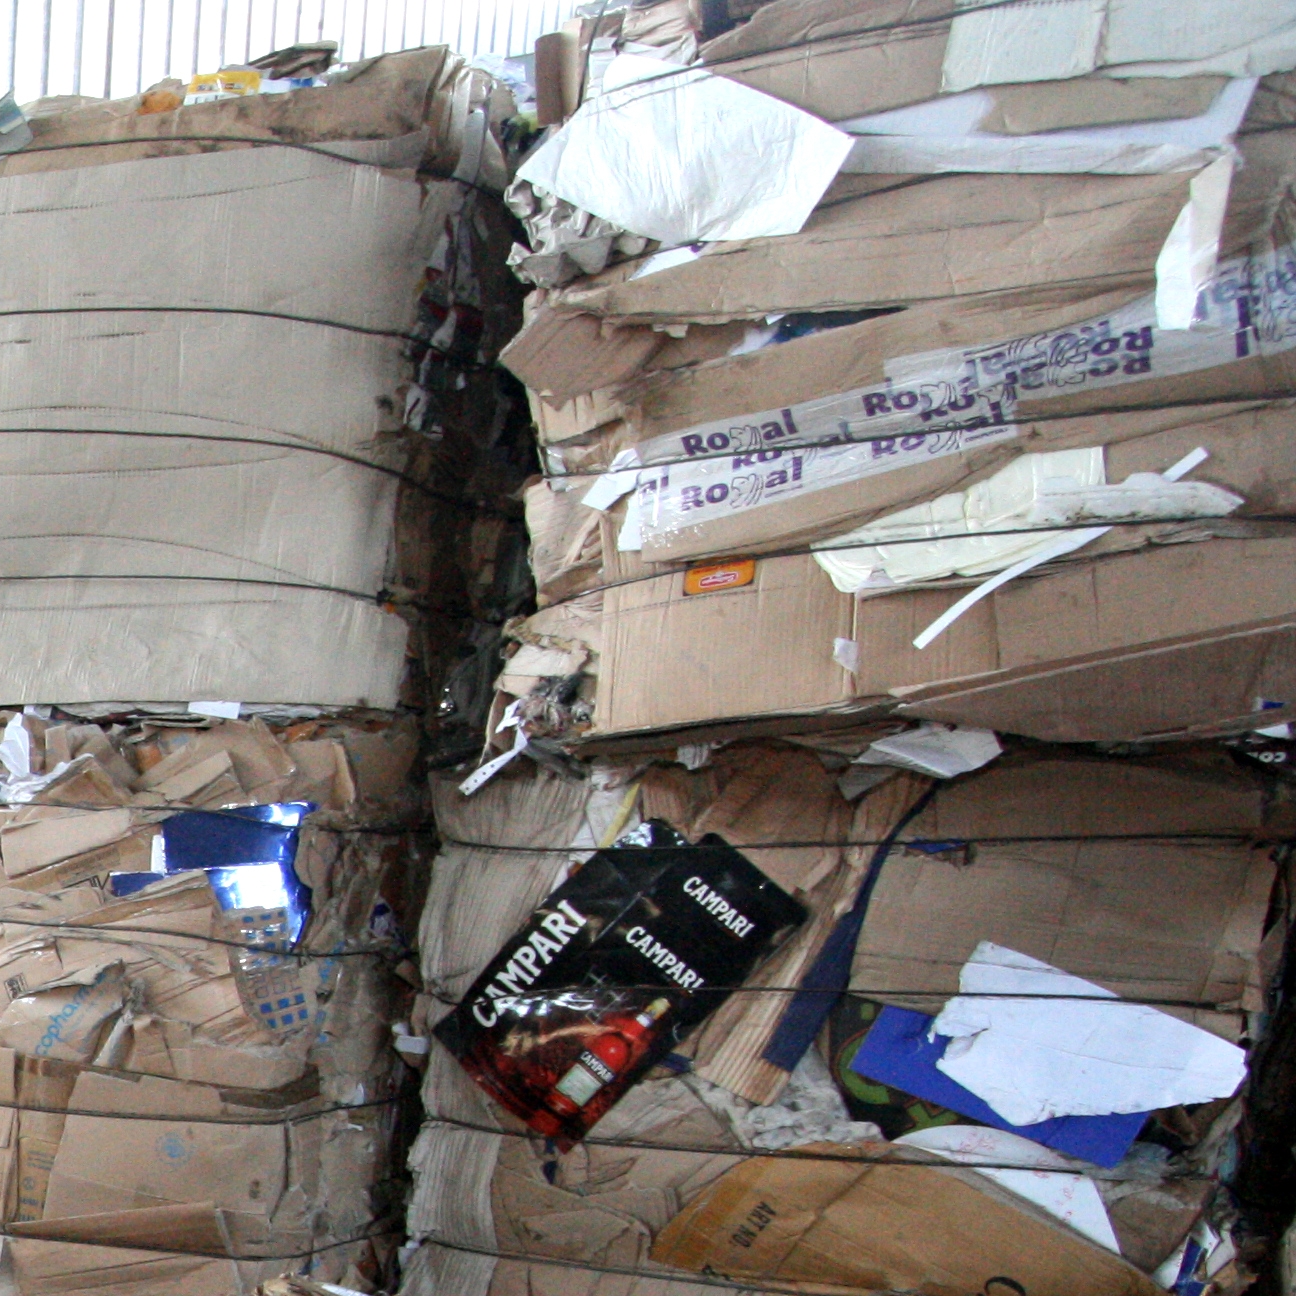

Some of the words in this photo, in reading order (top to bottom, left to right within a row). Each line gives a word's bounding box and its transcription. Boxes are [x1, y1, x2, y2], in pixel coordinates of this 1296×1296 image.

[683, 876, 755, 938] CAMPARI
[473, 900, 587, 1028] CAMPARI
[625, 926, 705, 993] CAMPARI
[730, 1226, 759, 1249] NO.
[751, 1201, 777, 1232] ART
